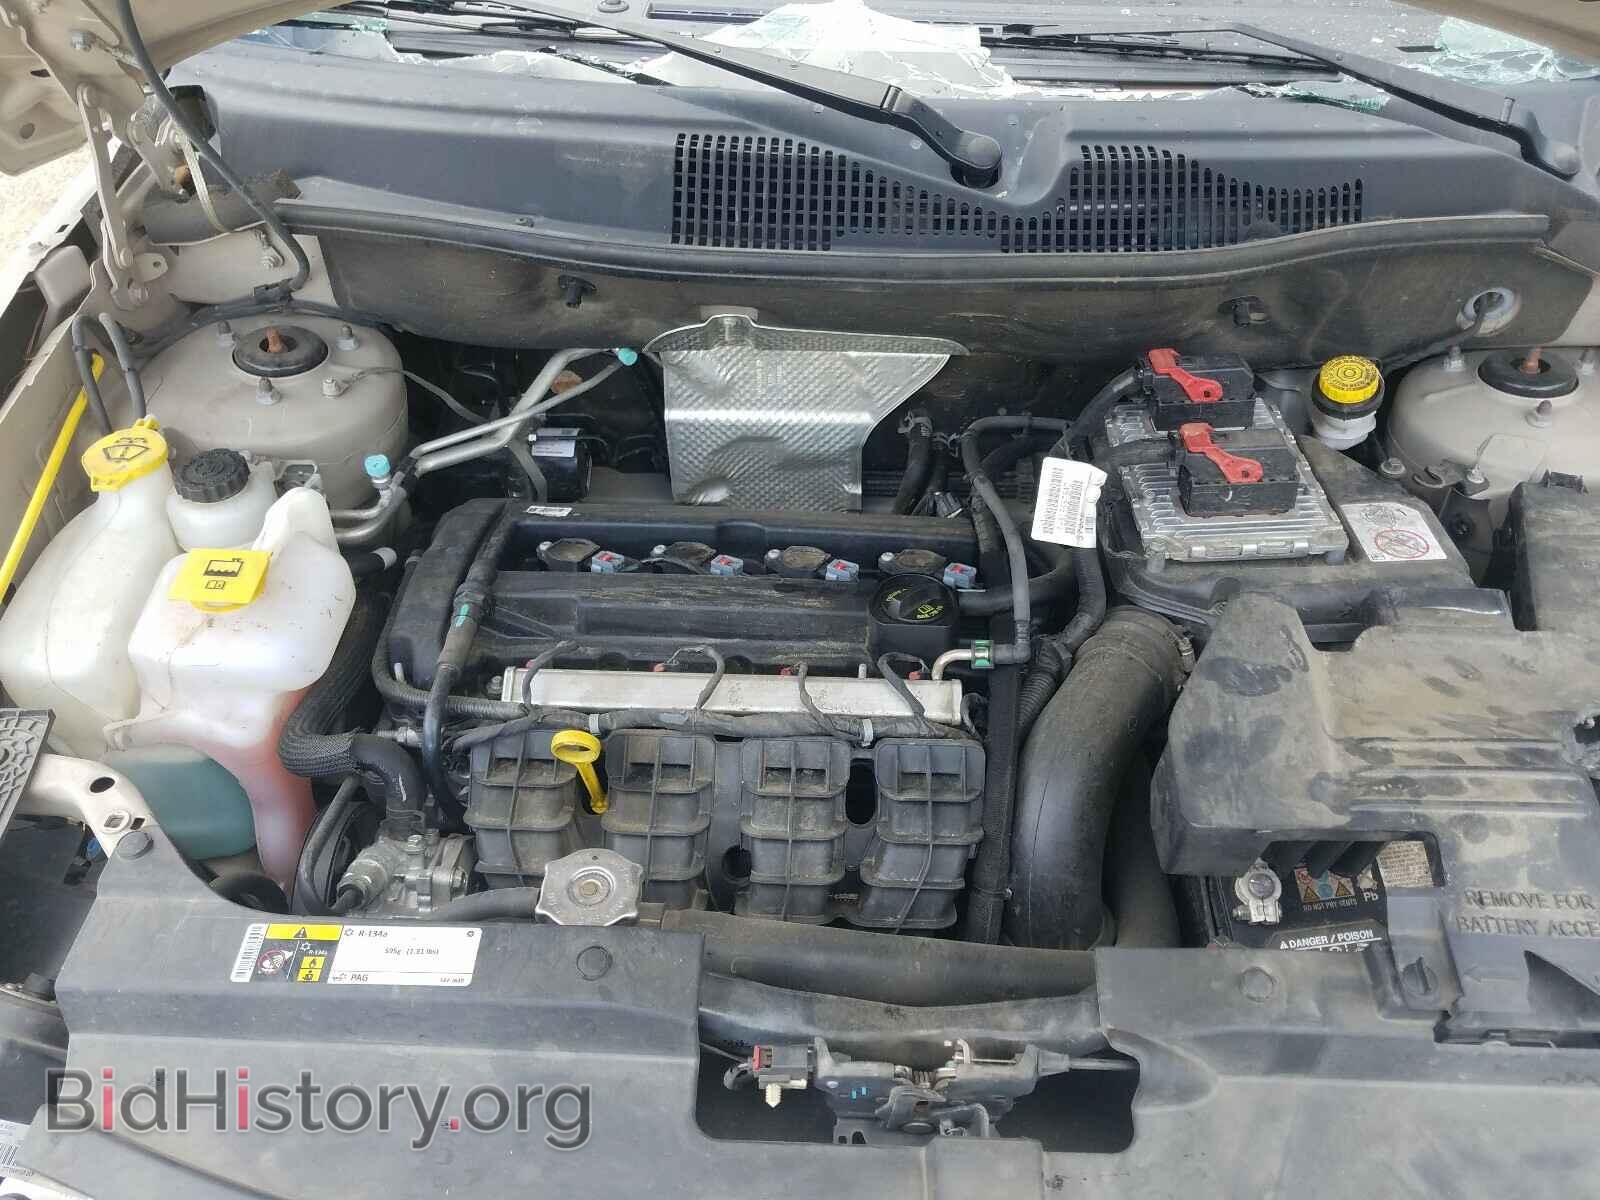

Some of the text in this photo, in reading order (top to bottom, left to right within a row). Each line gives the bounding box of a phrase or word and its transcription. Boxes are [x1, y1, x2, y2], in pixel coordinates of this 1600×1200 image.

[1363, 891, 1379, 902] Pb
[1464, 889, 1596, 910] REMOVE FOR
[1456, 915, 1537, 935] BATTERY
[1288, 935, 1329, 949] DANGER
[1337, 929, 1374, 942] POISON
[350, 973, 369, 982] PAG
